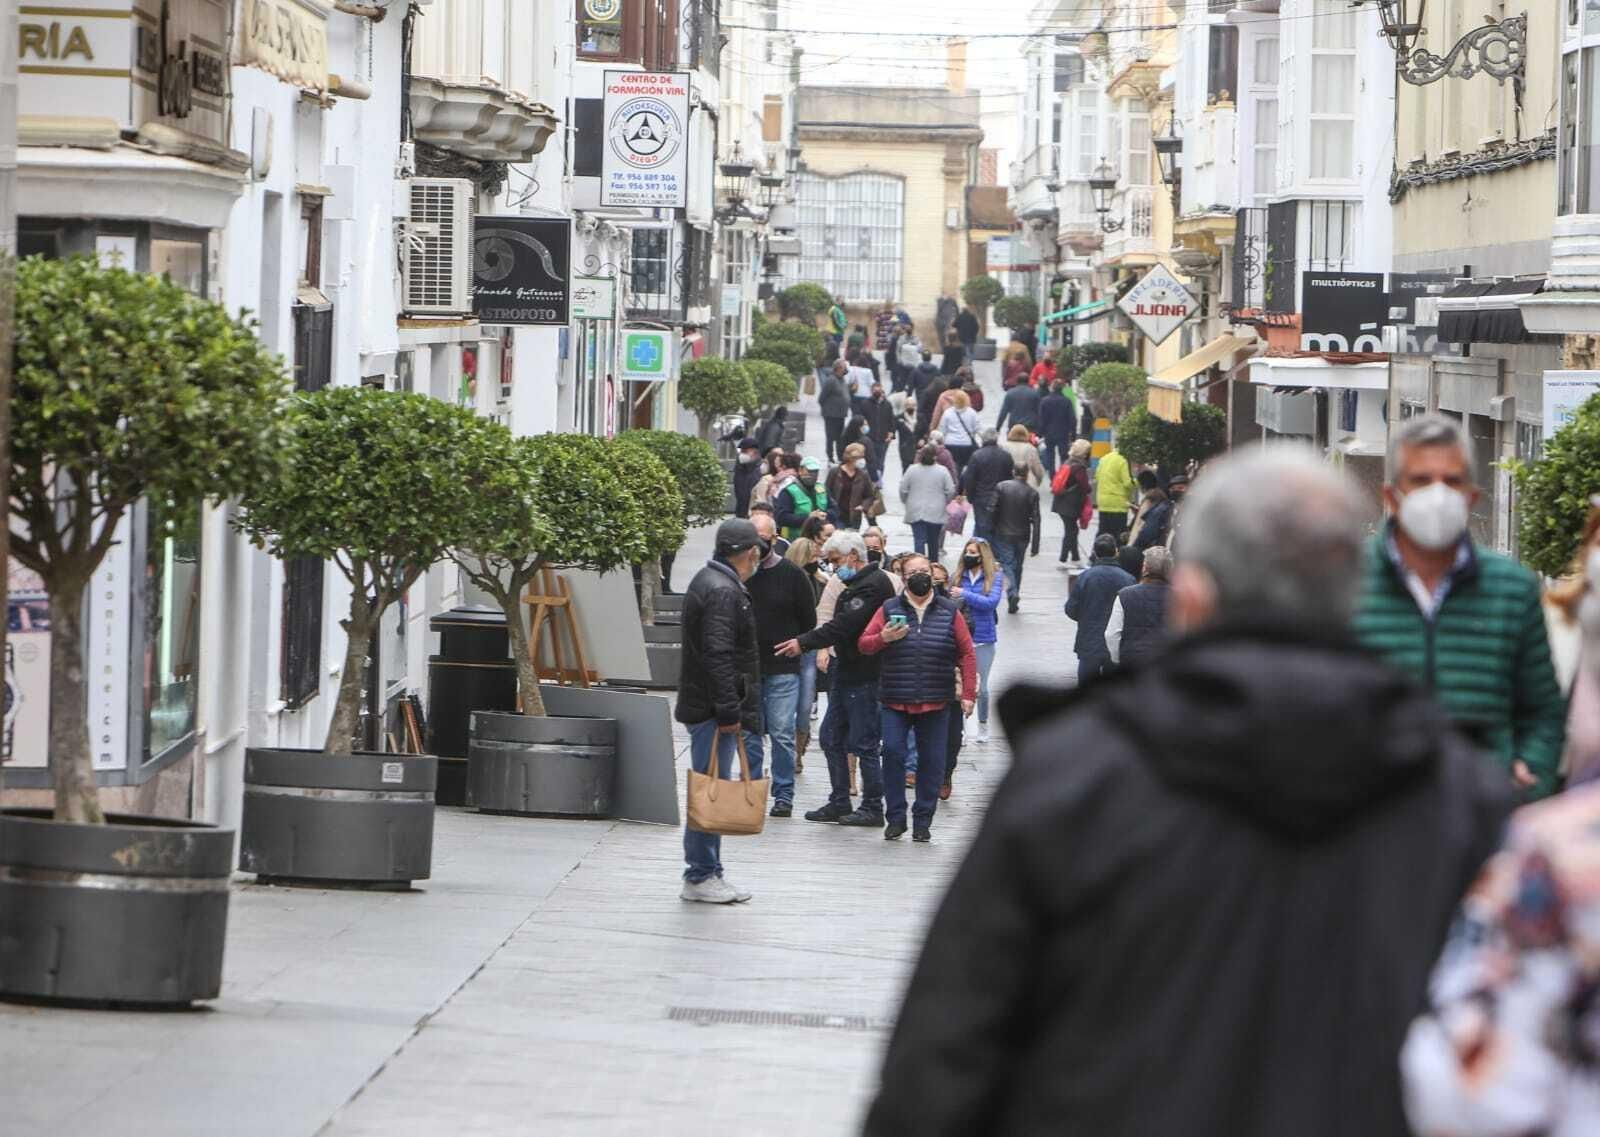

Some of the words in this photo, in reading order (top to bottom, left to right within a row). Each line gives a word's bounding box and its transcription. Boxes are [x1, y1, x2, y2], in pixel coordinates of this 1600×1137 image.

[621, 75, 657, 84] CENTRO
[660, 76, 672, 84] DE
[666, 87, 685, 96] VIAL
[622, 102, 671, 121] AUTOESCUELA
[630, 154, 659, 163] DIEGO
[1129, 303, 1187, 316] JIJONA
